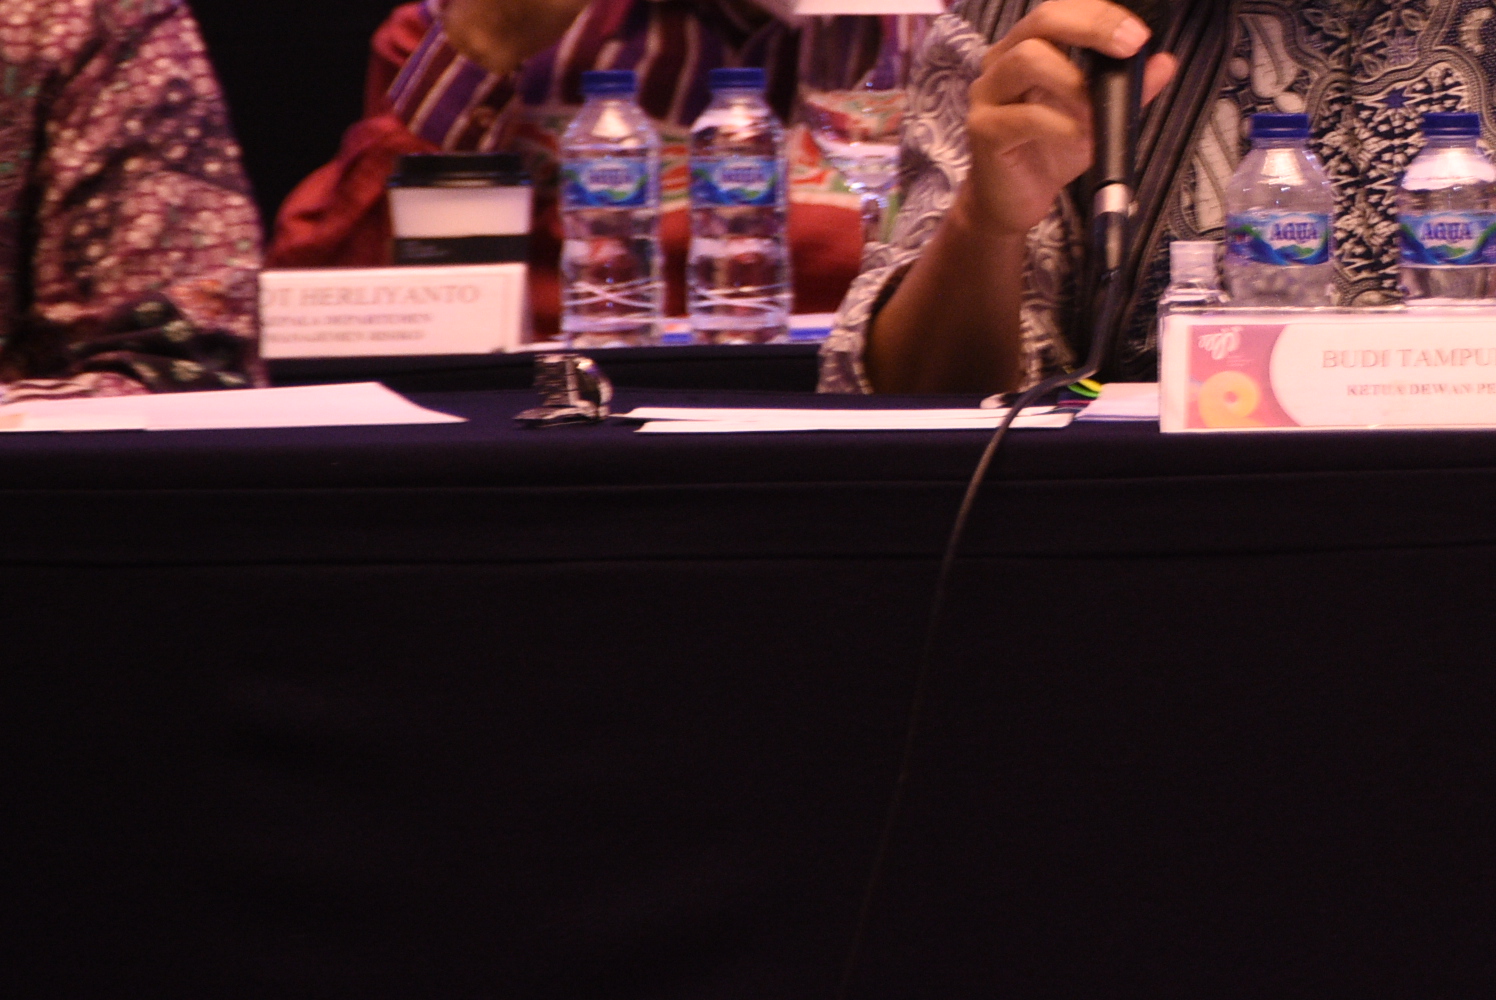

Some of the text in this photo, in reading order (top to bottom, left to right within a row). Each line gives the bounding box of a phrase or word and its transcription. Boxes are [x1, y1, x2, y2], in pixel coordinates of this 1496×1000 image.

[1270, 221, 1318, 243] AQUA
[1420, 221, 1473, 244] AQUA
[1321, 348, 1390, 369] BUDI
[1409, 382, 1472, 396] DEWAN
